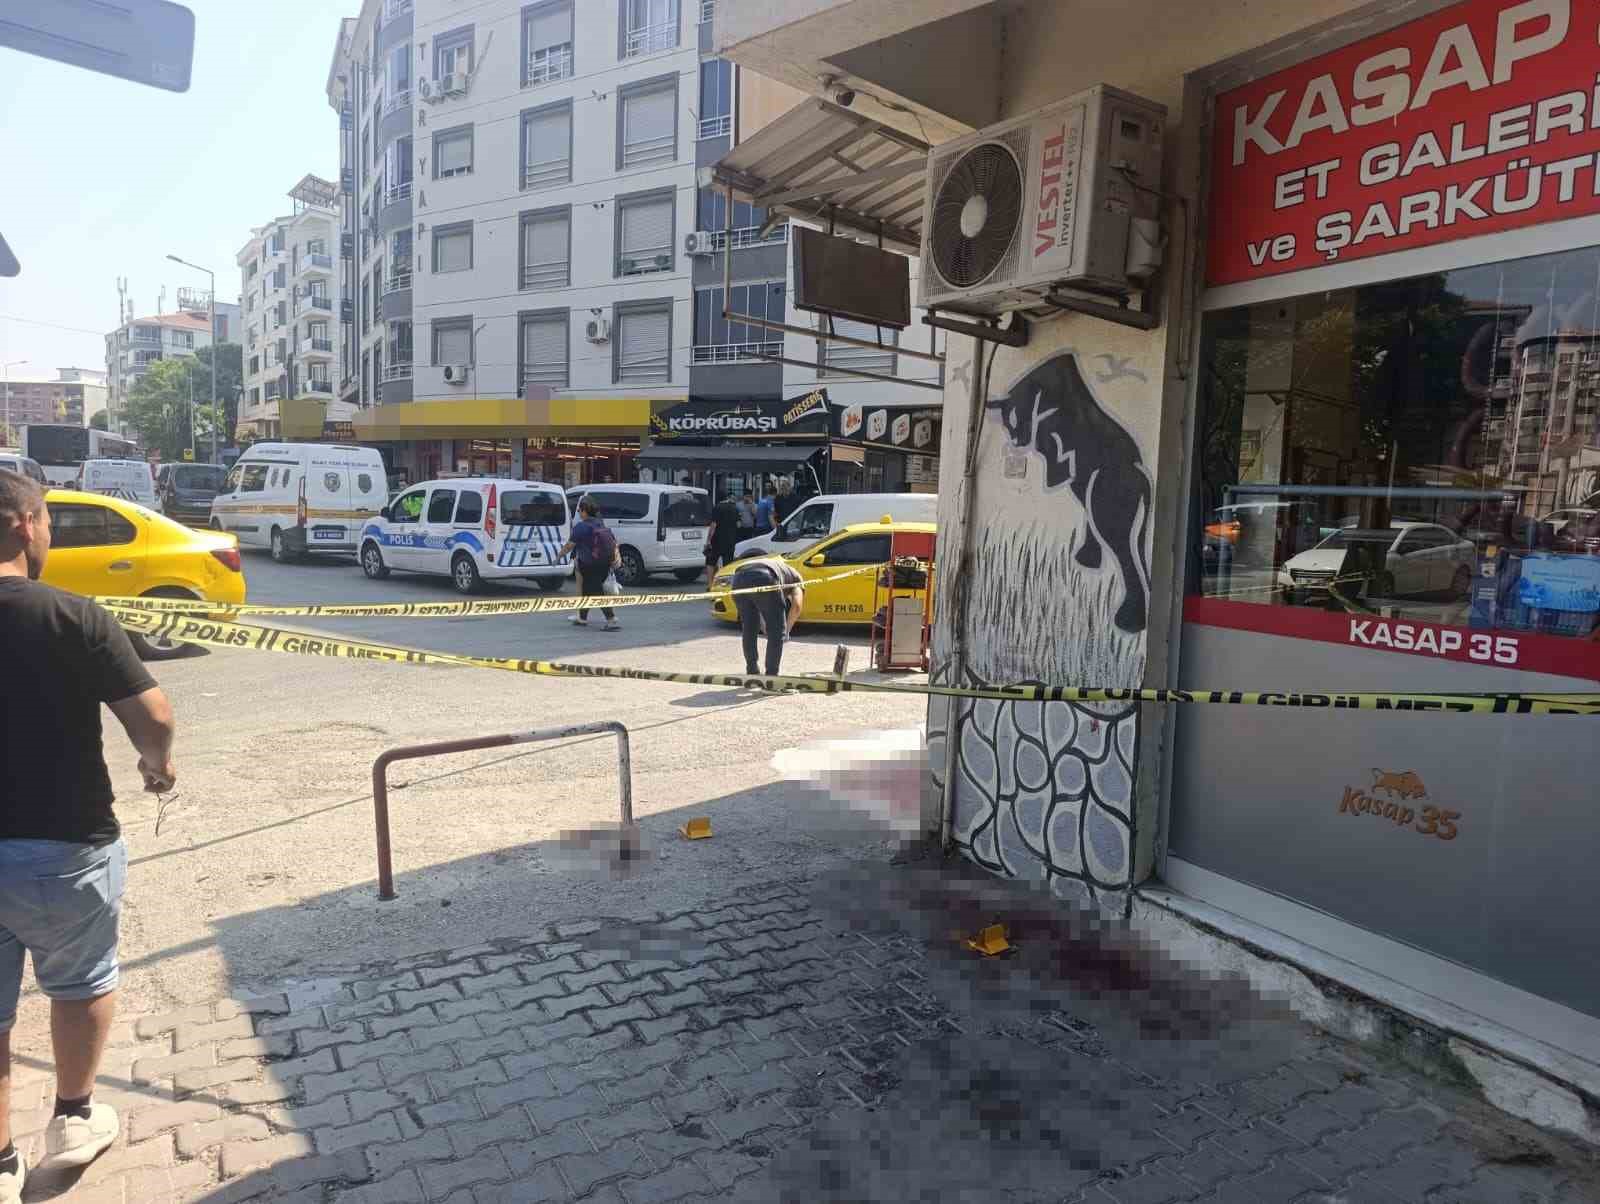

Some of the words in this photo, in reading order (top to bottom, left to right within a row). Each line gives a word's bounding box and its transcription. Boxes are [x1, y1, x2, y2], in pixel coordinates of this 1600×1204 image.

[1232, 0, 1571, 166] KASAP
[1034, 122, 1066, 258] VESTEL
[1273, 158, 1341, 210] ET
[1247, 233, 1296, 267] ve
[669, 413, 778, 432] KÖPRÜBAŞI
[824, 604, 833, 613] 35
[1348, 619, 1462, 655] KASAP
[1469, 634, 1519, 664] 35
[1338, 785, 1415, 826] Kasap
[1415, 804, 1462, 841] 35
